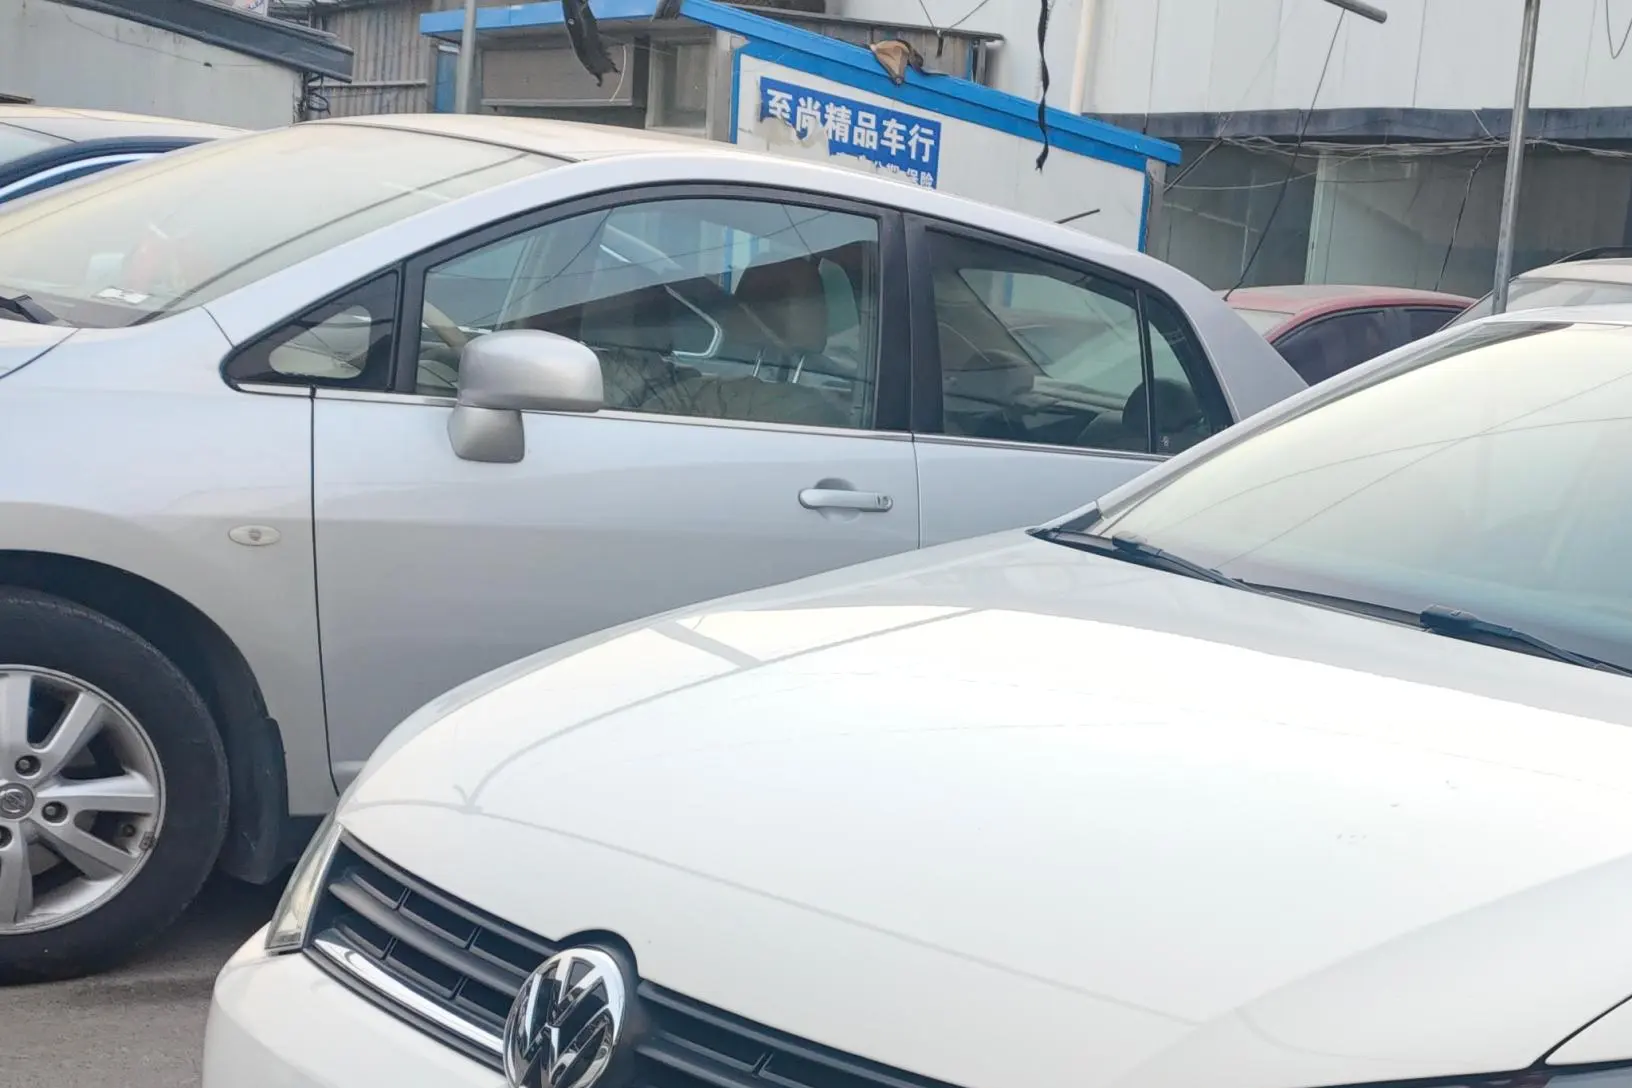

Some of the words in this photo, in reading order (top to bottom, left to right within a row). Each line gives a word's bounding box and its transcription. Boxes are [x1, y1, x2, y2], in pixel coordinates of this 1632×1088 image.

[766, 88, 936, 164] 至尚精品车行
